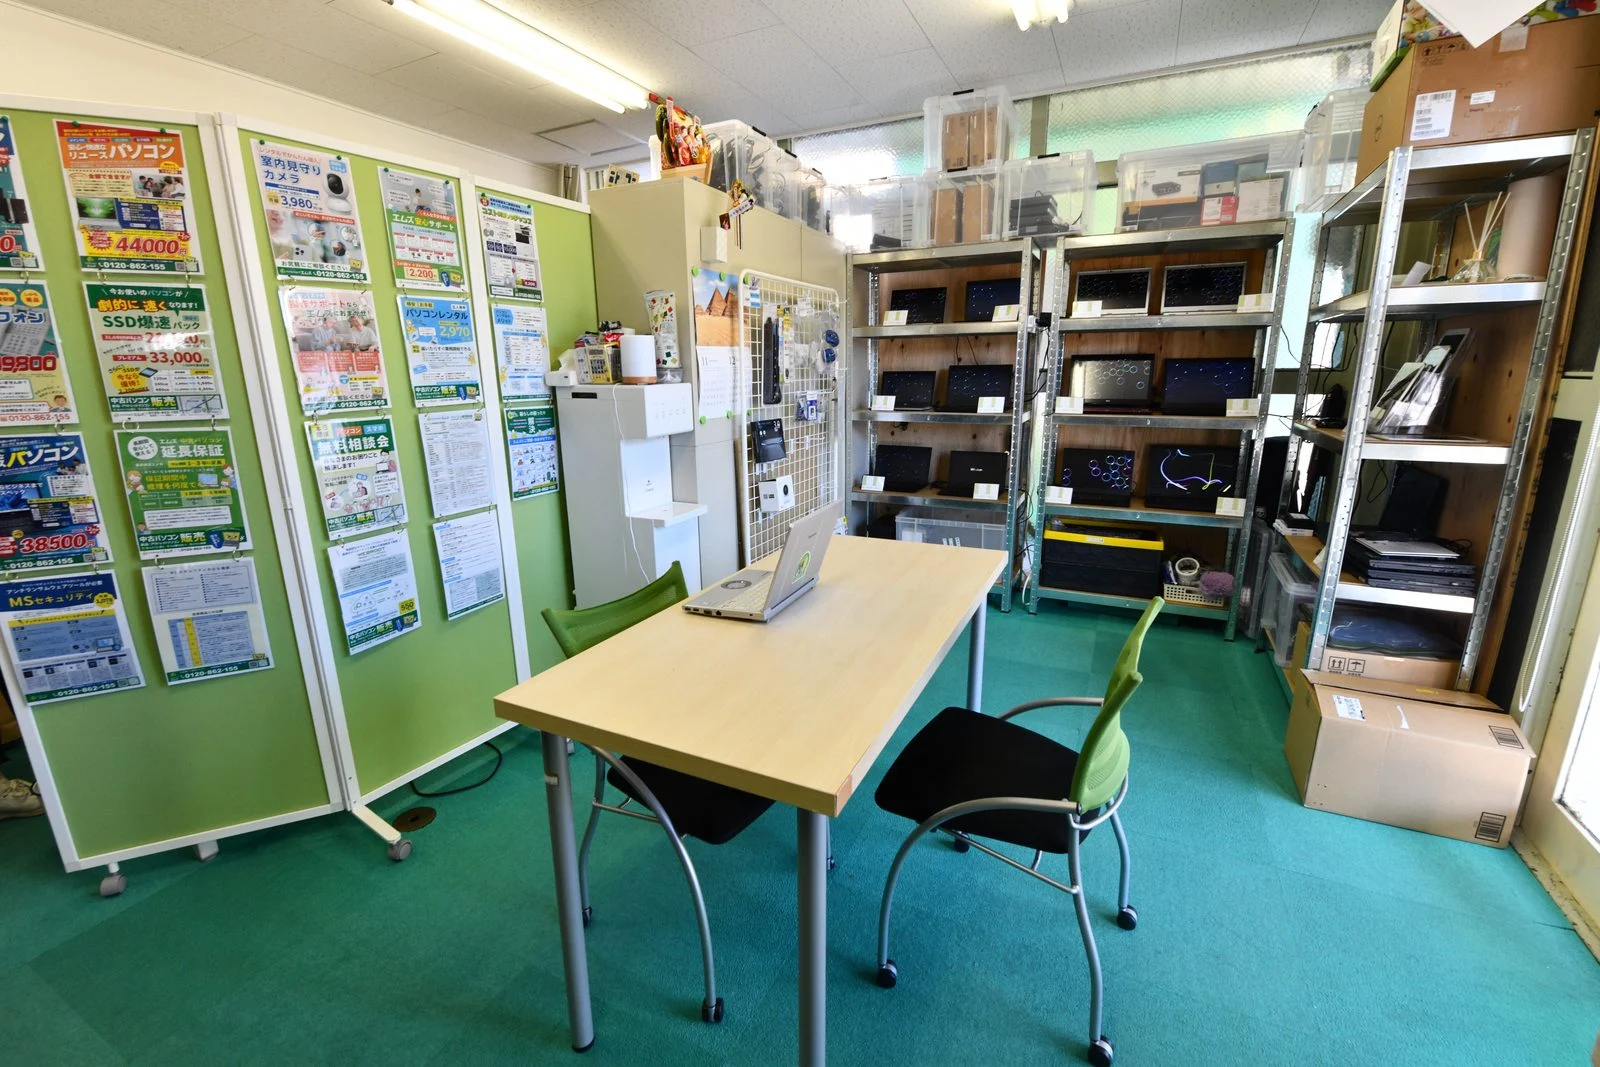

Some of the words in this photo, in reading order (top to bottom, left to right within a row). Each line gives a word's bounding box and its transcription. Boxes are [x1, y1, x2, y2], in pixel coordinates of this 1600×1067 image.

[69, 151, 108, 160] リユース
[109, 143, 175, 160] パソコン
[260, 155, 321, 176] 室内見守り
[264, 169, 300, 184] カメラ
[281, 195, 313, 209] 3,980
[392, 213, 454, 231] エムズ安心サポート
[116, 237, 180, 254] 44000
[103, 262, 166, 271] 0120-862-155
[316, 270, 365, 280] 0120-862-155
[109, 288, 183, 297] 今お使いのパソコンが
[98, 299, 140, 312] 劇的に
[143, 300, 167, 312] 速く
[168, 301, 198, 309] なります!
[406, 308, 469, 320] パソコンレンタル
[102, 315, 172, 330] SSD爆速
[173, 321, 200, 330] パック
[439, 326, 471, 338] 2,970
[0, 355, 57, 373] 9,800
[149, 352, 202, 365] 33,000
[110, 396, 150, 404] 中古パソコン
[8, 413, 71, 422] 0120-862-155
[160, 444, 225, 458] 延長保証
[316, 435, 390, 455] 無料相談会
[21, 534, 88, 554] 38500
[139, 534, 179, 543] 中古パソコン
[10, 558, 74, 569] 0120-862-155
[9, 592, 94, 608] MSセキュリティ
[184, 665, 239, 679] 0120-862-155
[56, 682, 117, 697] 0120-862-155
